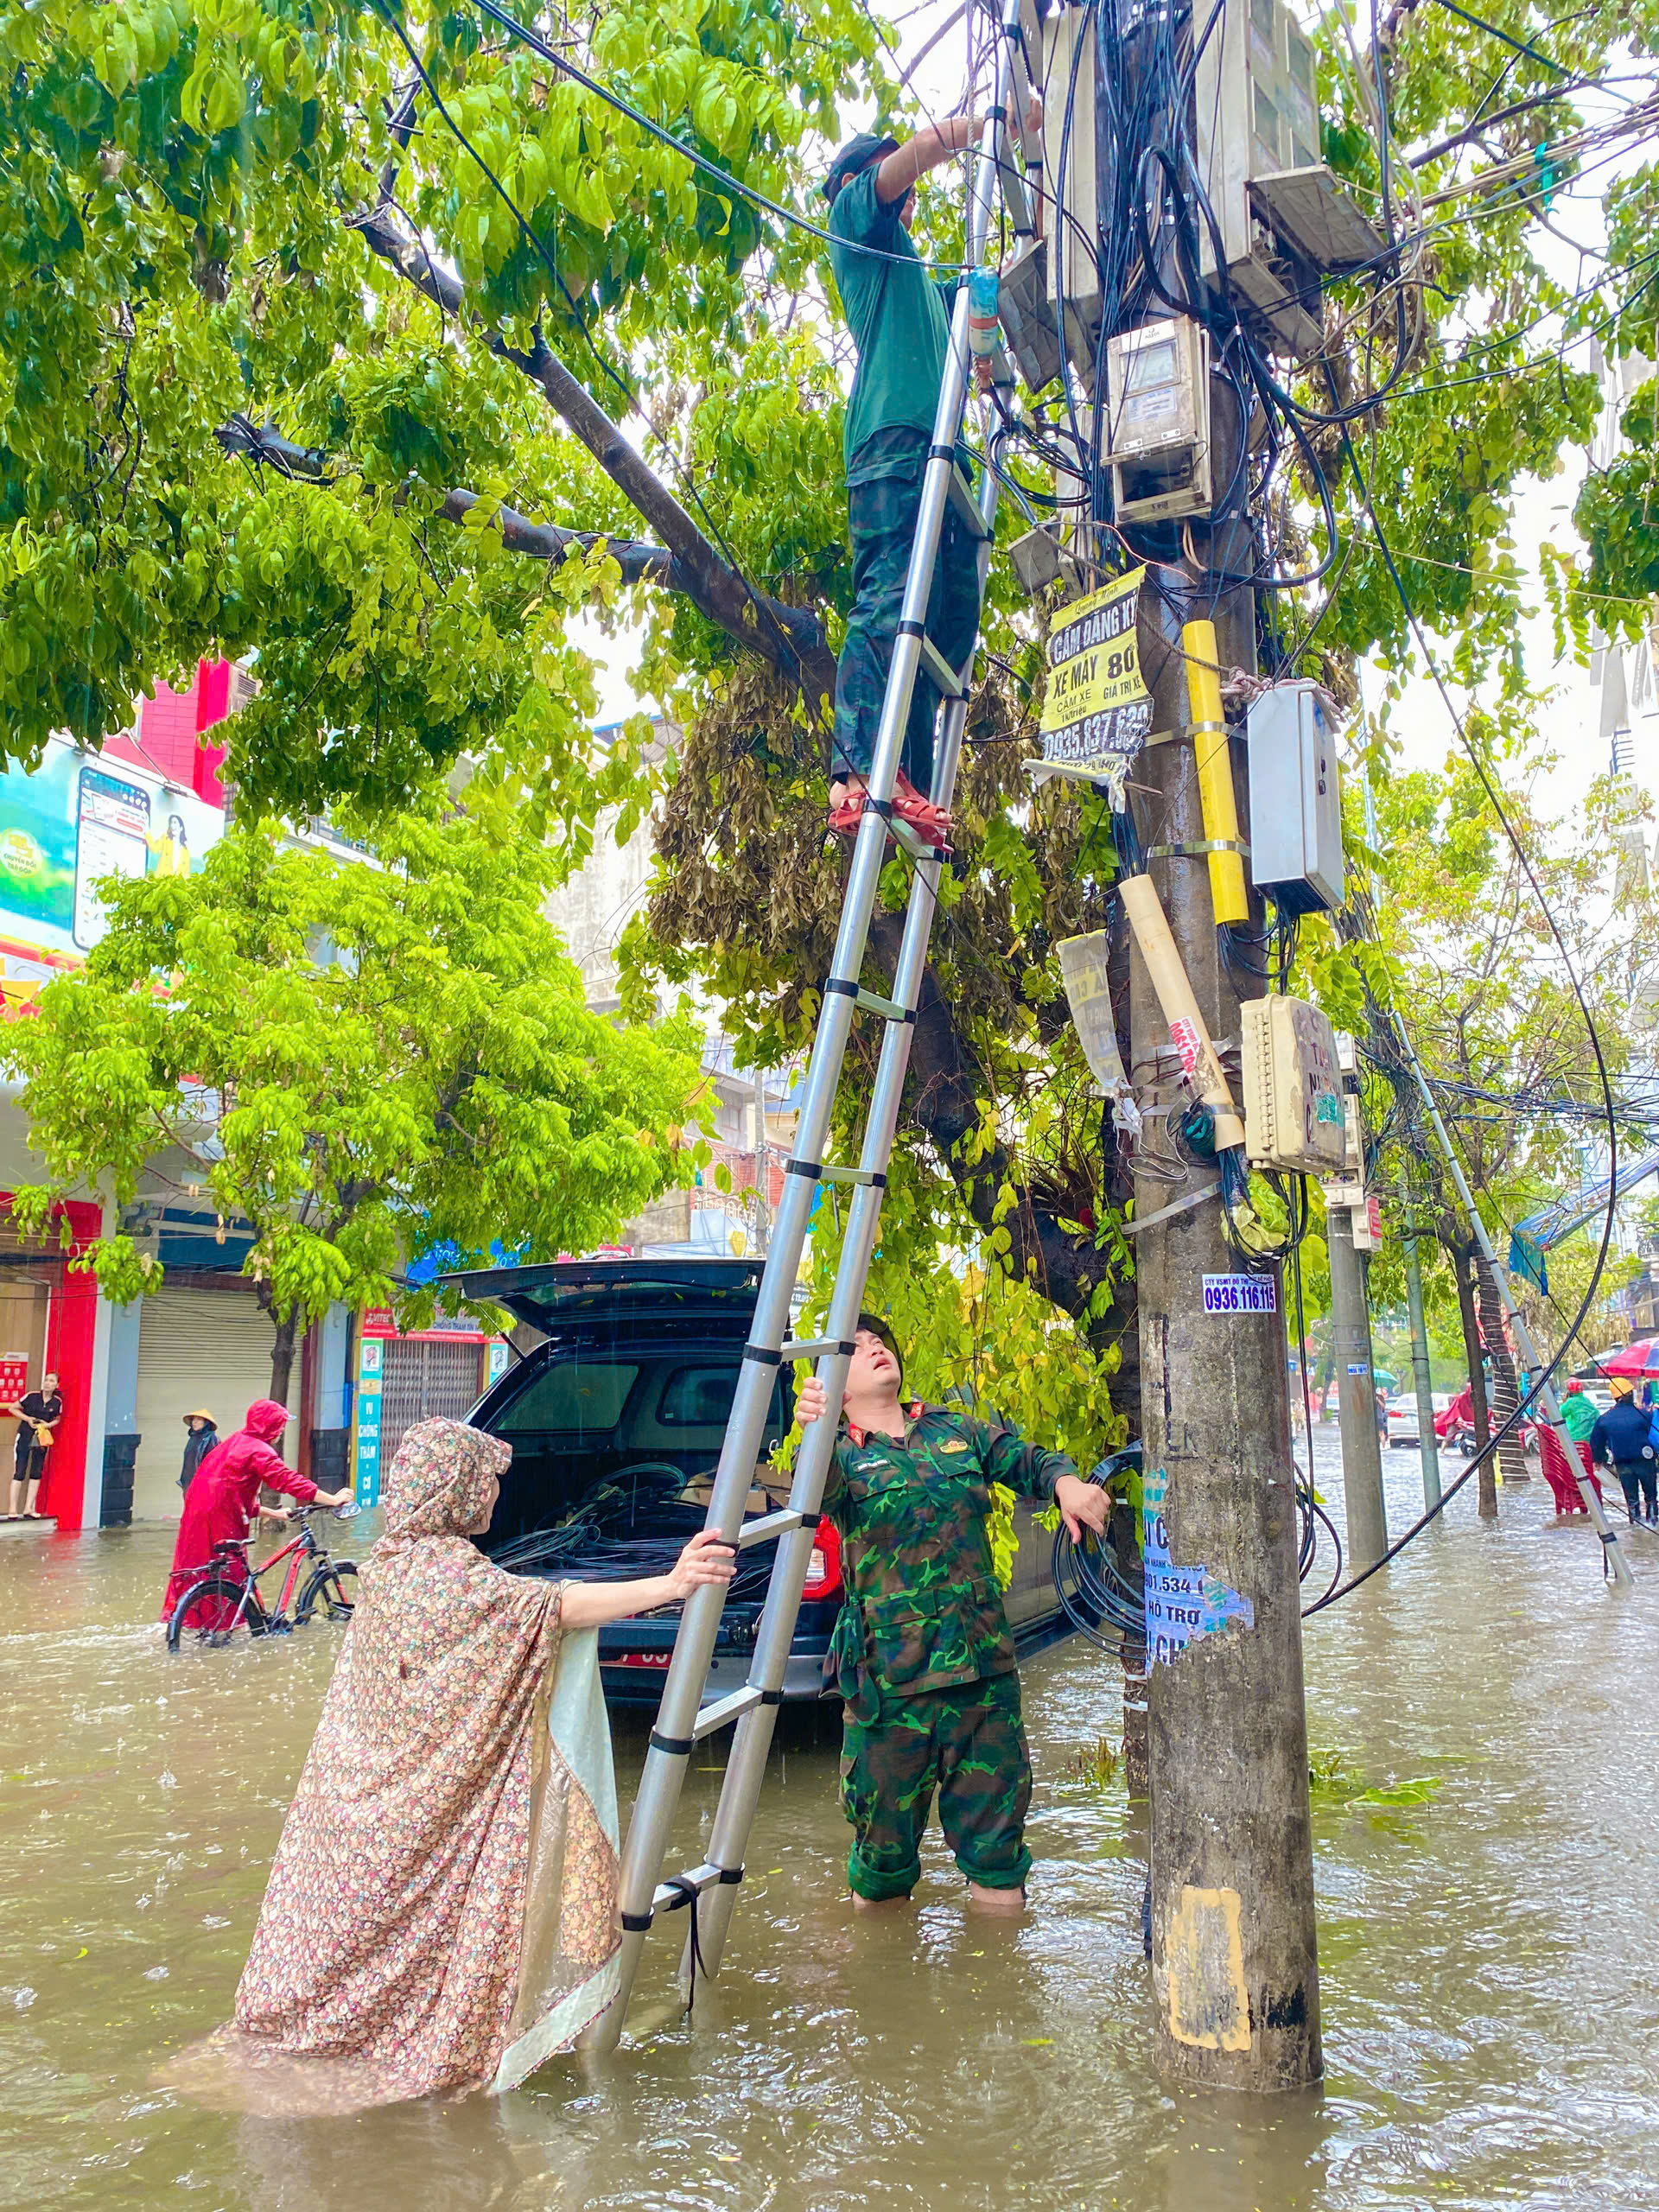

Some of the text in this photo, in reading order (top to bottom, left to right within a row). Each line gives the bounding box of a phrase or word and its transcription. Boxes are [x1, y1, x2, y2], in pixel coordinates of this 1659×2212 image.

[1052, 670, 1069, 700] XE
[1071, 652, 1099, 691] MÁY
[1205, 1286, 1274, 1310] 0936.116.115
